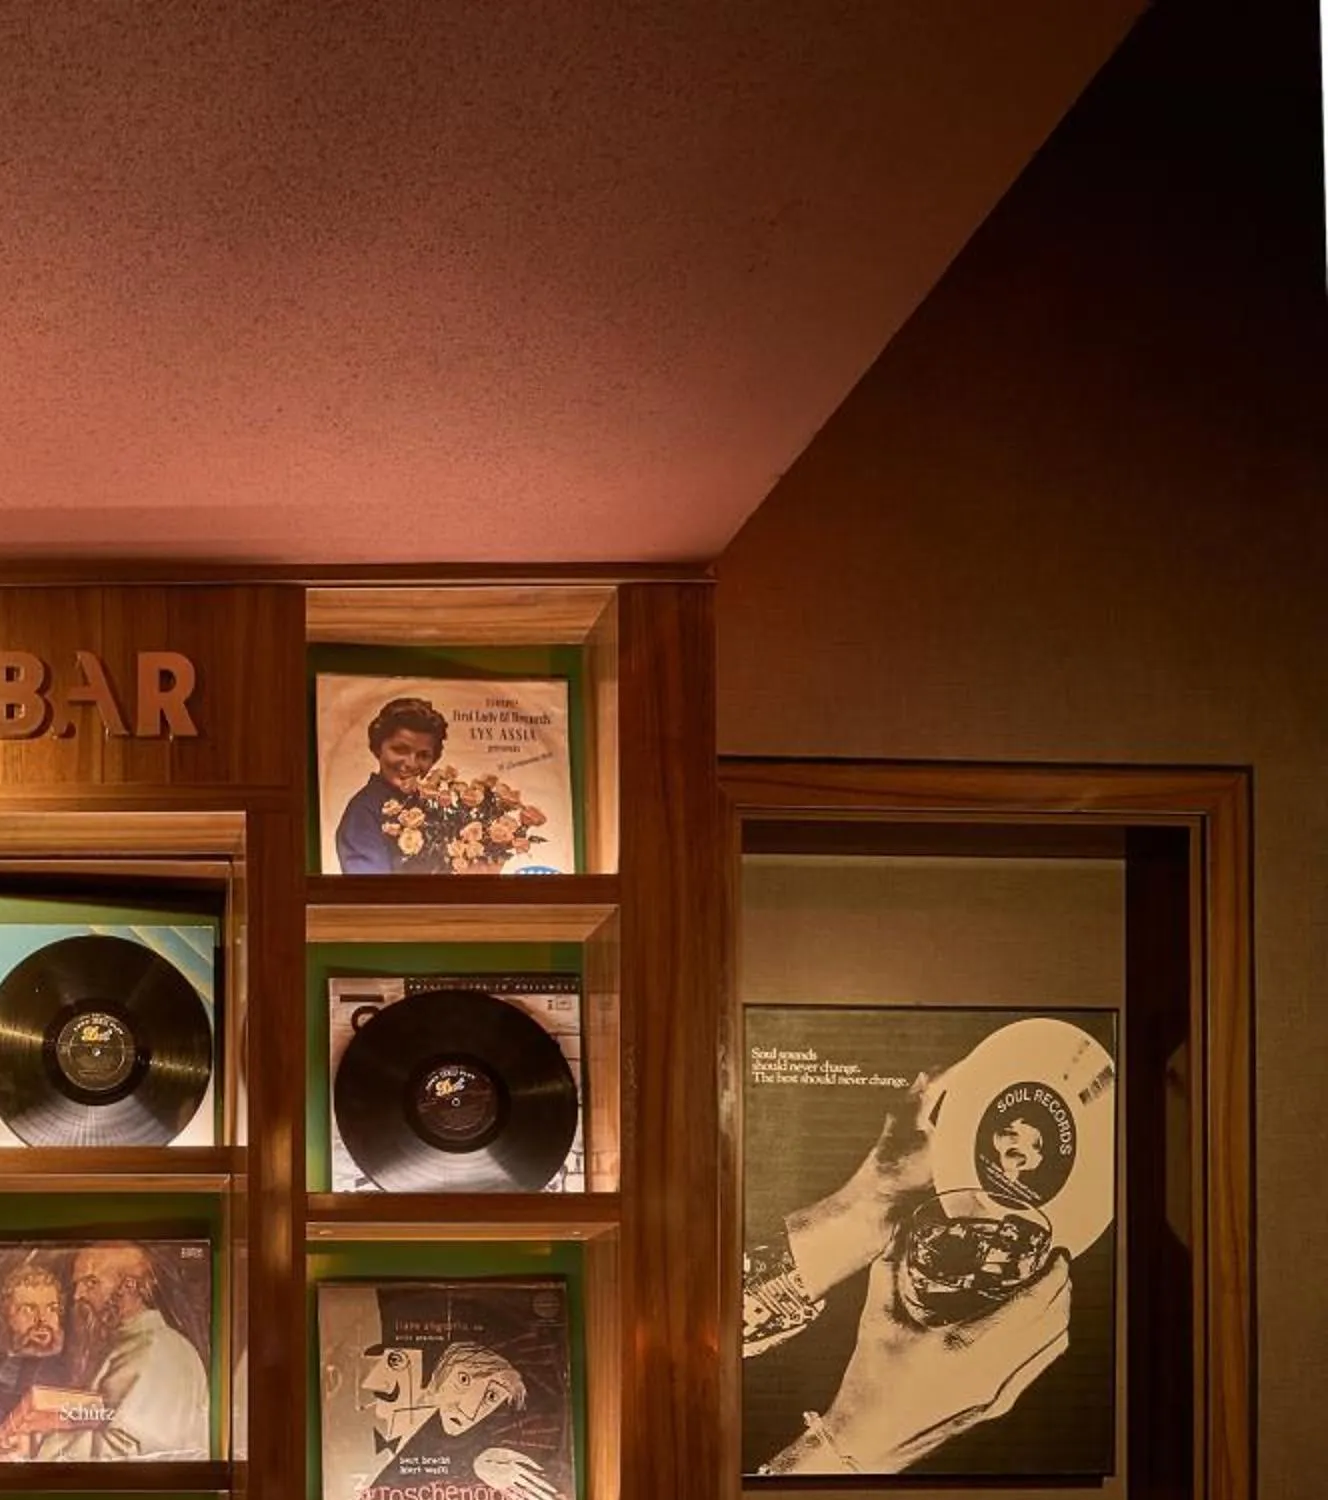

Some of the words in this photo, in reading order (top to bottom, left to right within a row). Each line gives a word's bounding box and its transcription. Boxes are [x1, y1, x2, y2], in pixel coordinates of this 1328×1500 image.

[751, 1047, 777, 1059] Soul
[778, 1048, 817, 1060] sounds
[751, 1060, 787, 1071] should
[789, 1063, 818, 1071] never
[819, 1060, 862, 1074] change.
[752, 1071, 775, 1083] The
[776, 1072, 798, 1083] best
[799, 1073, 837, 1084] should
[838, 1076, 868, 1084] never
[869, 1074, 910, 1087] change.
[997, 1087, 1032, 1113] SOUL
[1033, 1089, 1074, 1156] RECORDS
